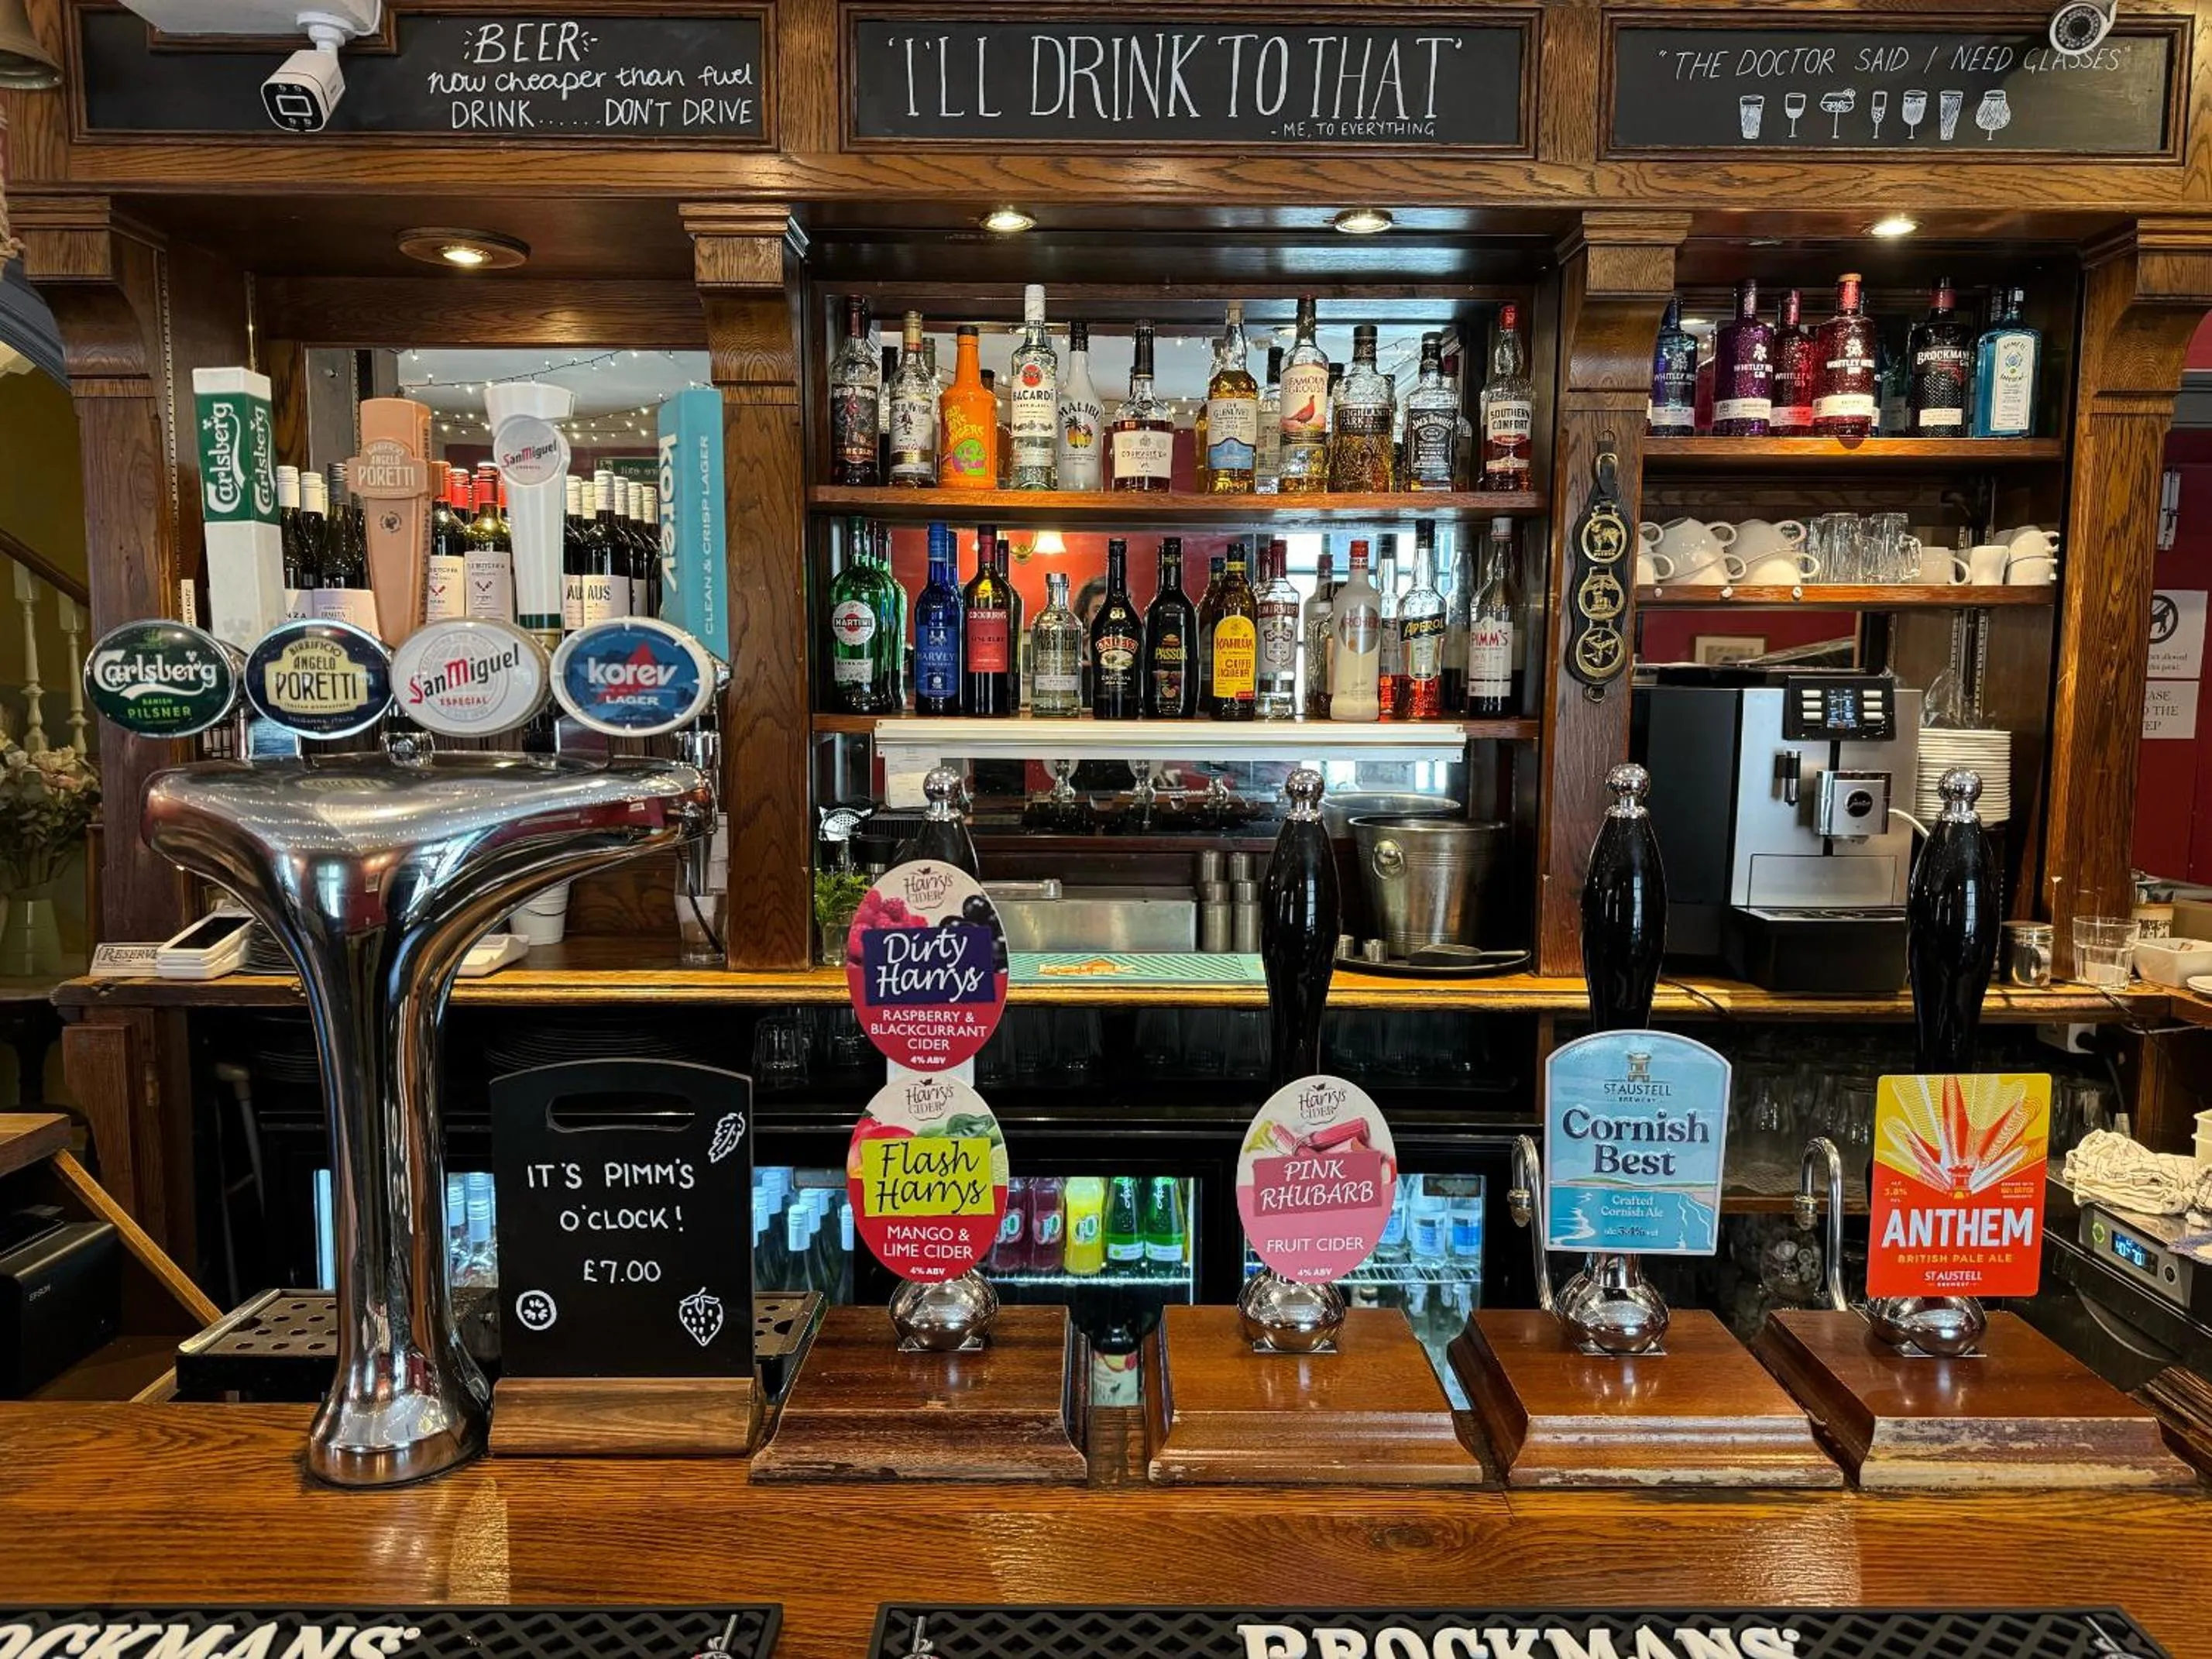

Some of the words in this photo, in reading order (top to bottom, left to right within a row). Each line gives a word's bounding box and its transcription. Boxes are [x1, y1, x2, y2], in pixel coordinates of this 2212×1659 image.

[473, 22, 580, 64] BEER
[1736, 48, 1838, 78] DOCTOR
[1854, 46, 1910, 74] SAID
[1950, 46, 2014, 73] NEED
[428, 70, 486, 94] now
[495, 70, 607, 101] cheaper
[615, 67, 685, 88] than
[697, 63, 753, 85] fuel
[1030, 33, 1206, 122] DRINK
[1218, 33, 1290, 118] TO
[682, 98, 753, 125] DRIVE
[1317, 122, 1334, 136] TO
[1340, 120, 1436, 138] EVERYTHING
[358, 466, 415, 487] PORETTI
[699, 434, 709, 496] LAGER
[658, 432, 679, 594] korev
[701, 498, 713, 555] CRISP
[702, 562, 712, 575] &
[704, 582, 714, 637] CLEAN
[94, 649, 218, 699] Carlsberg
[293, 656, 336, 671] ANGELO
[587, 657, 678, 686] korev
[275, 672, 358, 701] PORETTI
[605, 695, 659, 706] LAGER
[127, 706, 192, 720] PILSNER
[439, 696, 490, 706] ESPECIAL
[2152, 706, 2179, 716] THE
[883, 928, 968, 969] Dirty
[876, 963, 984, 1004] Harrys
[882, 1009, 961, 1023] RASPBERRY
[965, 1012, 975, 1023] &
[871, 1023, 988, 1038] BLACKCURRANT
[907, 1038, 950, 1051] CIDER
[1561, 1107, 1710, 1144] Cornish
[527, 1162, 584, 1190] IT'S
[603, 1157, 696, 1190] PIMM'S
[880, 1140, 981, 1179] Flash
[1283, 1158, 1348, 1183] PINK
[1592, 1143, 1677, 1176] Best
[875, 1177, 988, 1214] Harrys
[1260, 1180, 1374, 1211] RHUBARB
[1613, 1194, 1654, 1206] Crafted
[1600, 1206, 1644, 1217] Cornish
[1646, 1207, 1664, 1218] Ale
[887, 1224, 954, 1241] MANGO
[957, 1228, 971, 1242] &
[1881, 1207, 2035, 1249] ANTHEM
[883, 1243, 920, 1259] LIME
[923, 1244, 974, 1259] CIDER
[1266, 1238, 1312, 1254] FRUIT
[1316, 1236, 1365, 1252] CIDER
[1898, 1253, 1949, 1264] BRITISH
[1952, 1253, 1984, 1263] PALE
[1988, 1253, 2013, 1263] ALE
[582, 1258, 662, 1284] £7.00
